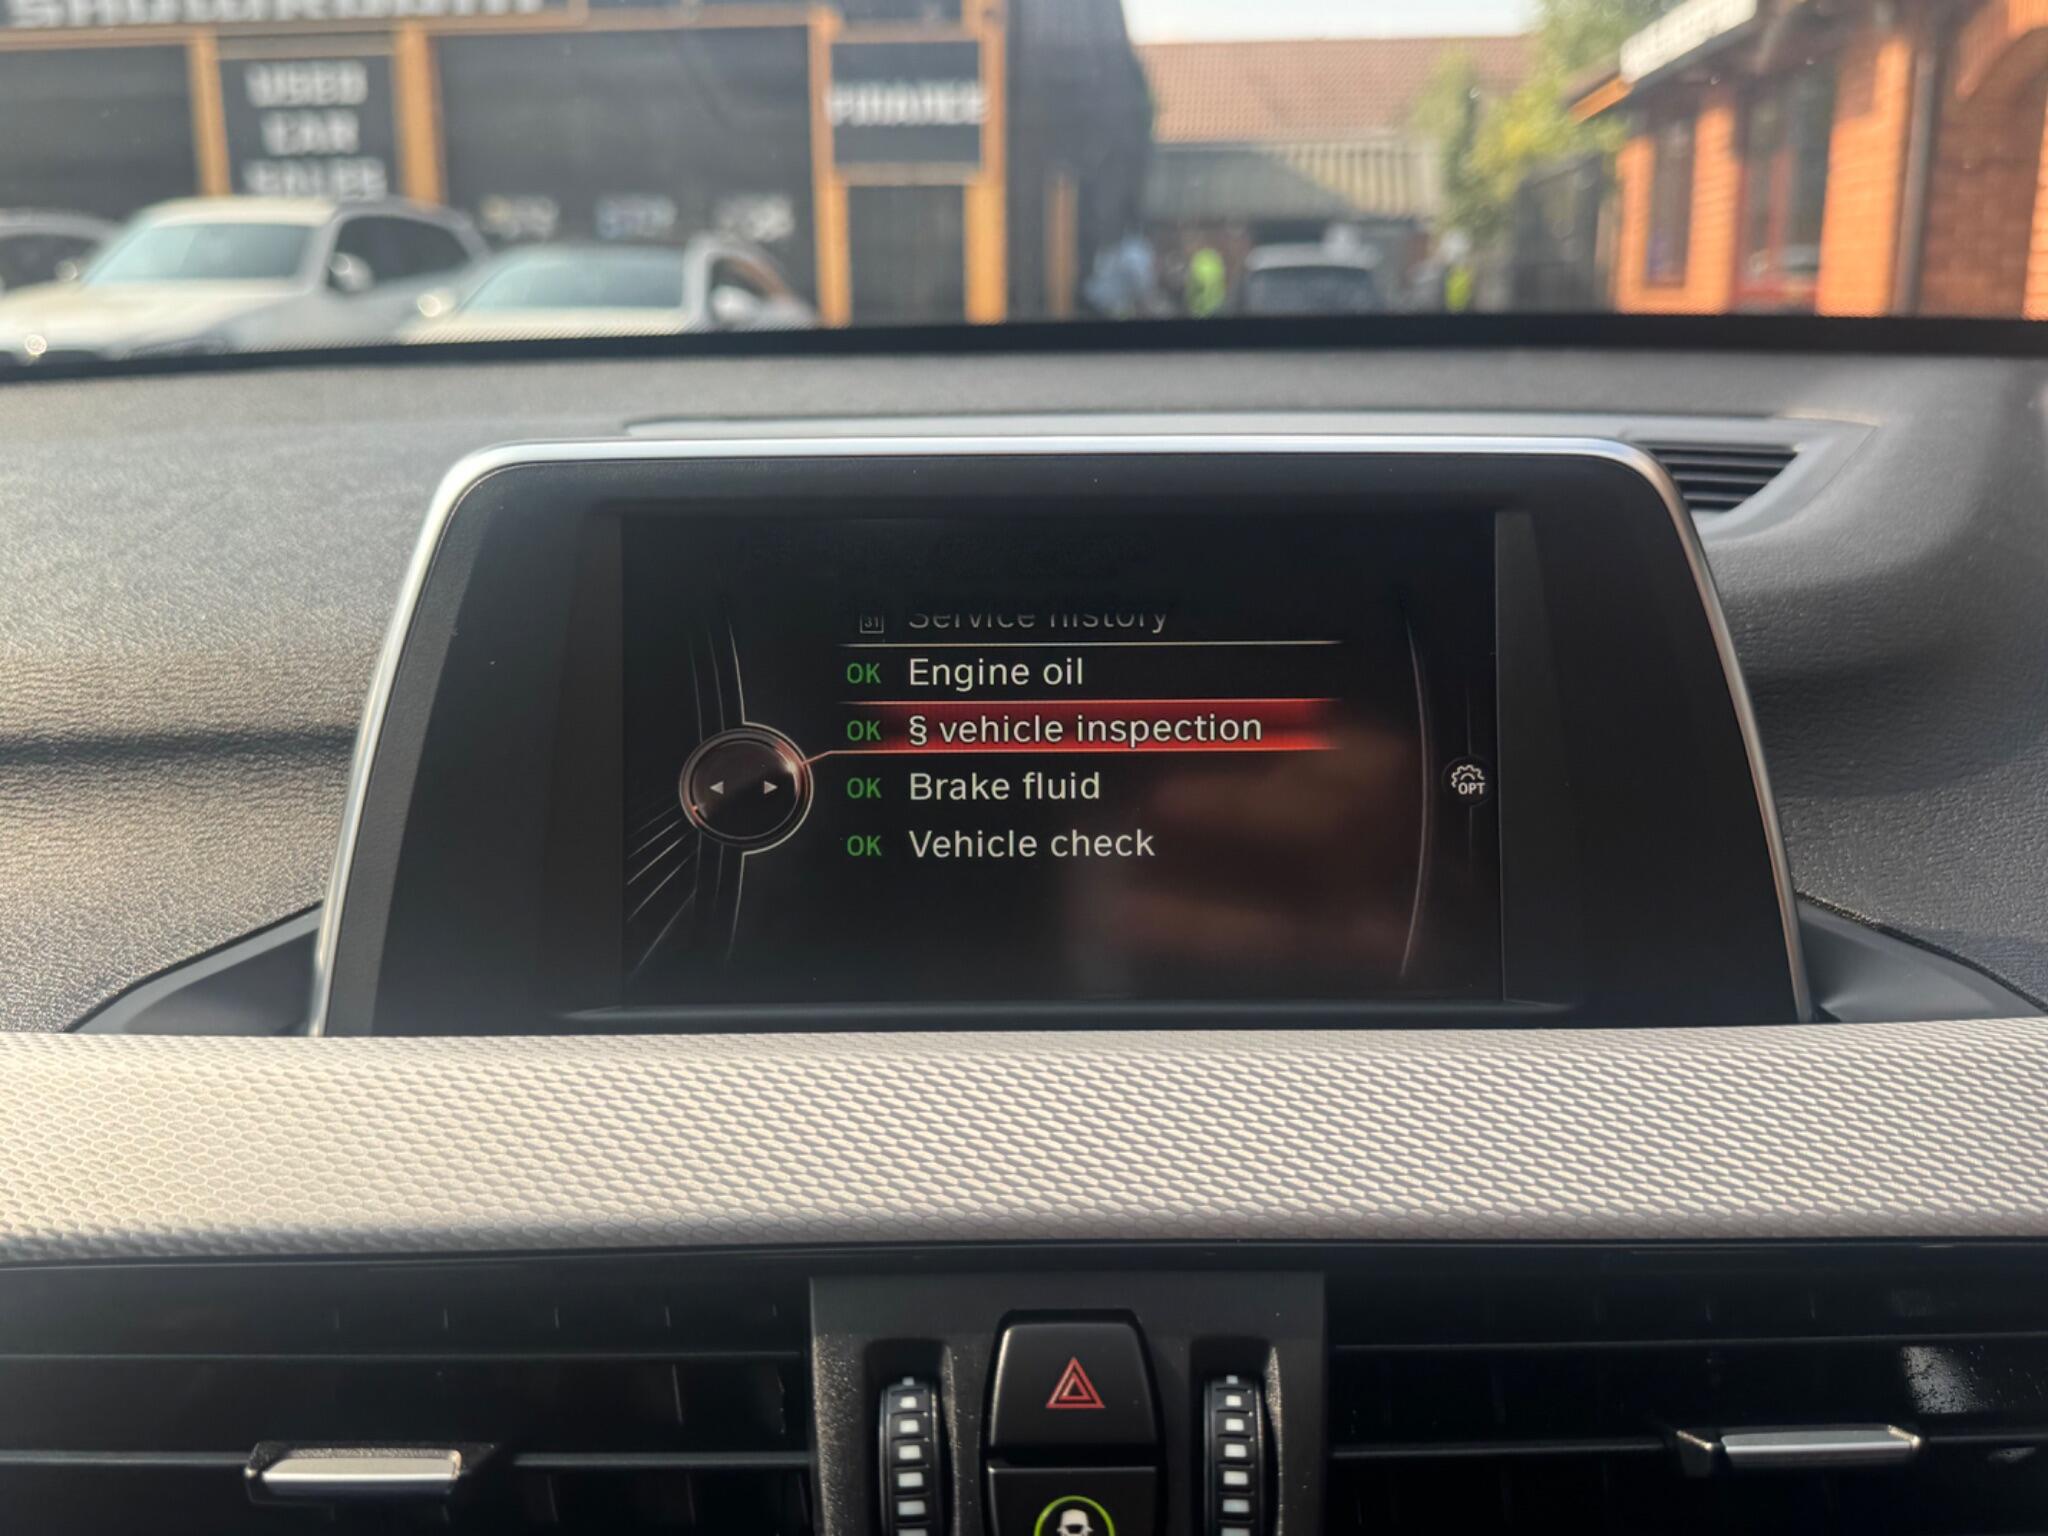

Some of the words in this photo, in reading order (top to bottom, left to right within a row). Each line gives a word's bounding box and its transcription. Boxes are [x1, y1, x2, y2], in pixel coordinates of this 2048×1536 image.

[245, 61, 367, 107] USED
[261, 110, 358, 154] CAR
[846, 662, 881, 684] OK
[909, 657, 1030, 692] Engine
[1043, 656, 1084, 685] oil
[846, 719, 881, 742] OK
[909, 715, 928, 746] §
[939, 716, 1064, 743] vehicle
[1077, 714, 1263, 749] inspection
[846, 777, 882, 799] OK
[909, 772, 1010, 800] Brake
[1022, 771, 1101, 800] fluid
[1458, 782, 1486, 795] OPT
[846, 834, 882, 857] OK
[908, 829, 1038, 858] Vehicle
[1049, 829, 1156, 858] check
